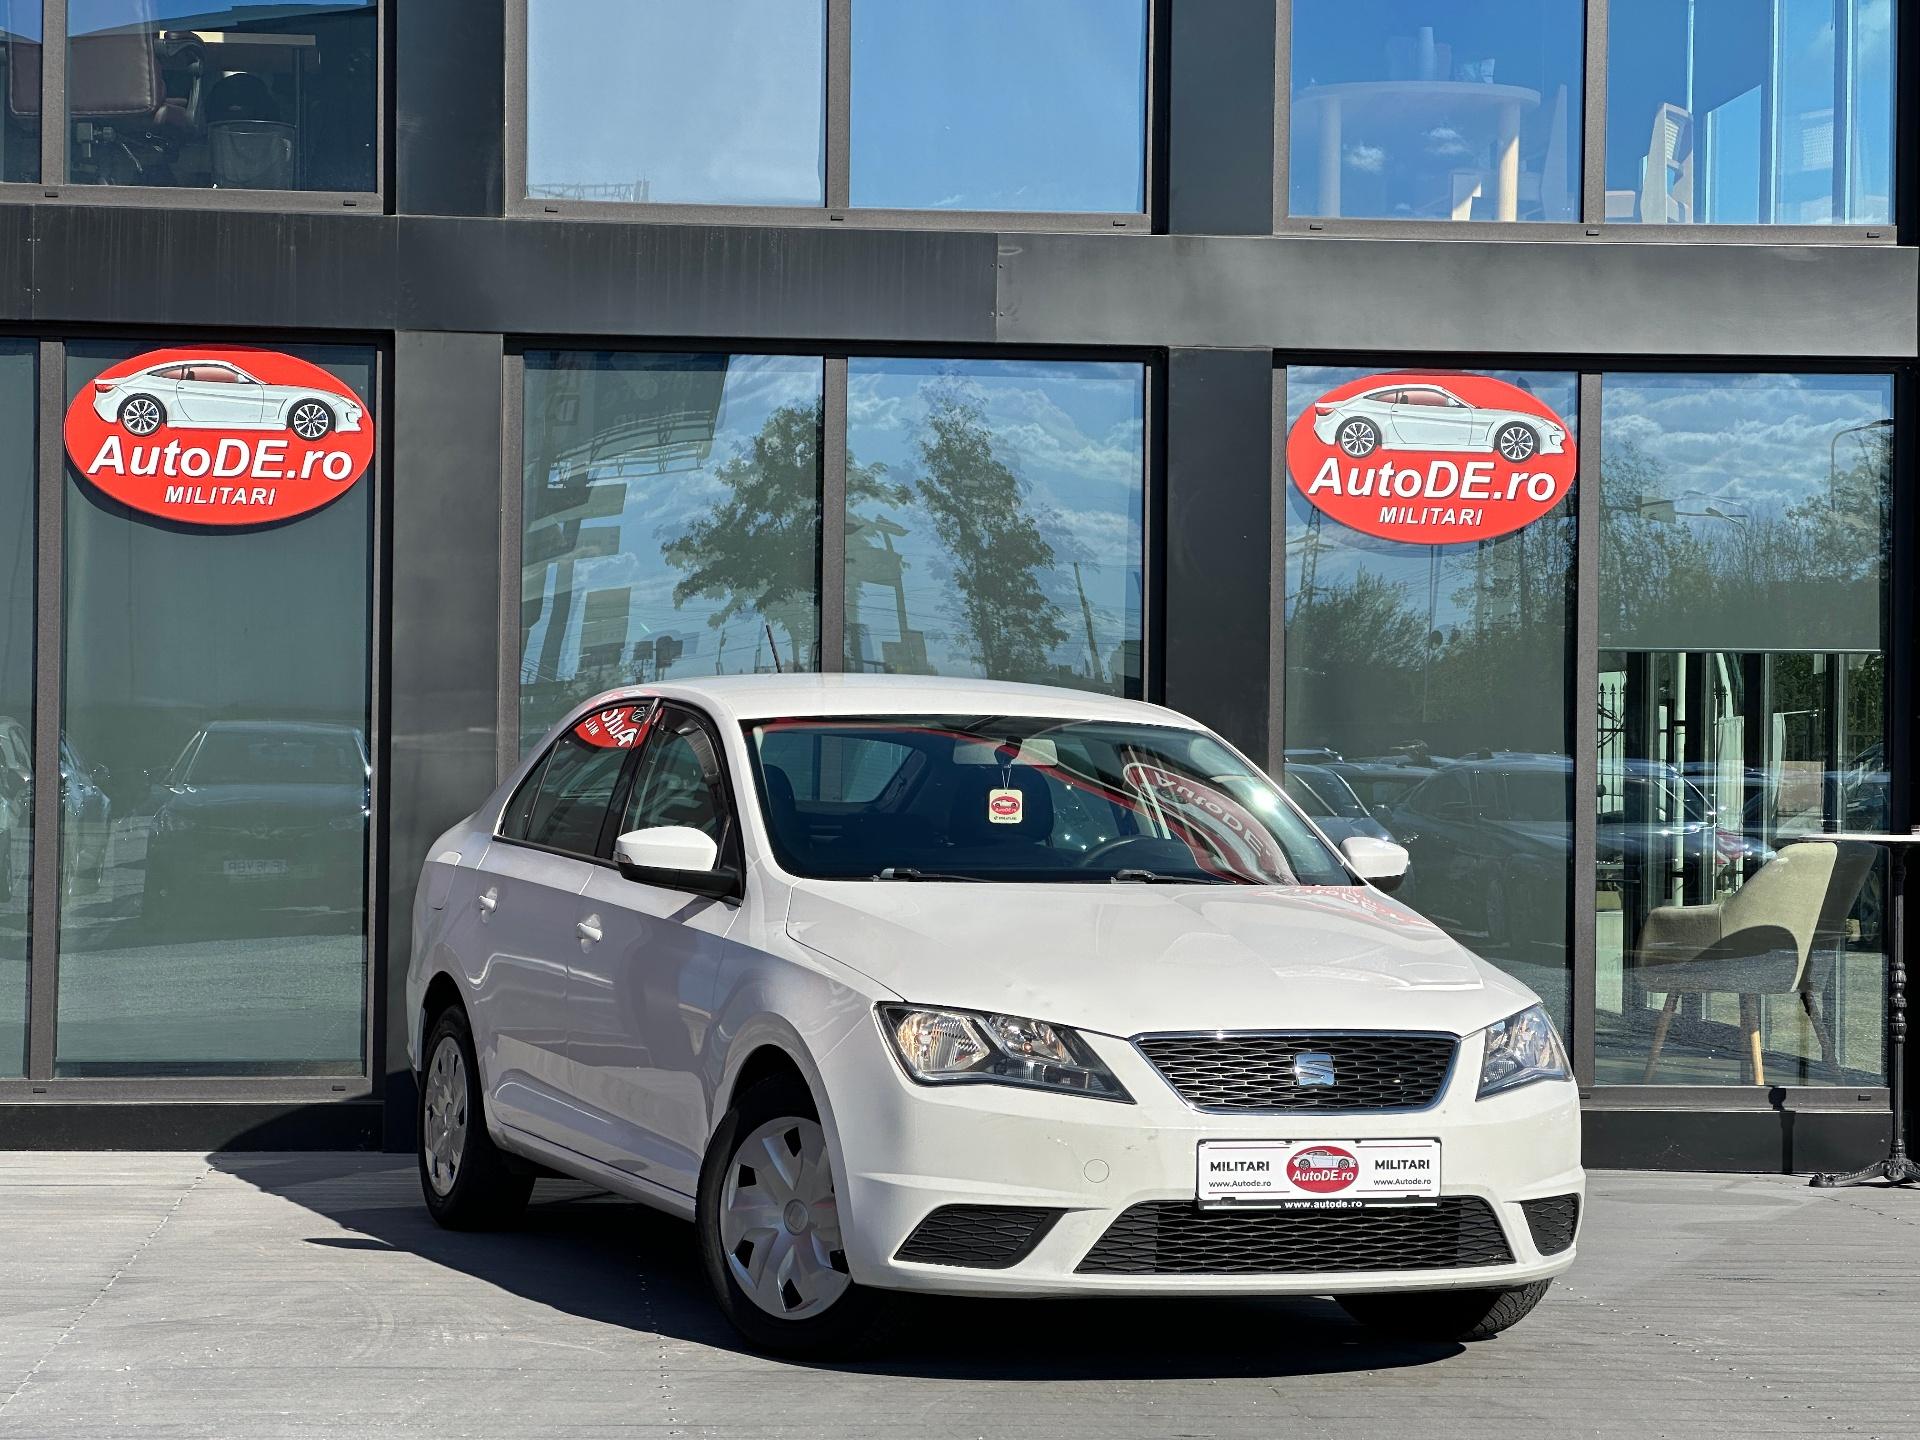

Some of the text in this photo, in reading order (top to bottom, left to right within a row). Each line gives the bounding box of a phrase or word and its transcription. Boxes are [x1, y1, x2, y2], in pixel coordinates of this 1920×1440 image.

[87, 436, 352, 481] AutoDE.ro
[1307, 457, 1556, 502] AutoDE.ro
[164, 486, 276, 505] MILITARI
[1379, 506, 1483, 526] MILITARI
[1210, 1161, 1270, 1172] MILITARI
[1374, 1159, 1430, 1170] MILITARI
[1292, 1169, 1355, 1183] AutoDE.ro
[1373, 1178, 1432, 1186] www.Autode.ro
[1208, 1180, 1272, 1188] www.Autode.ro
[1284, 1199, 1363, 1209] www.autode.ro
